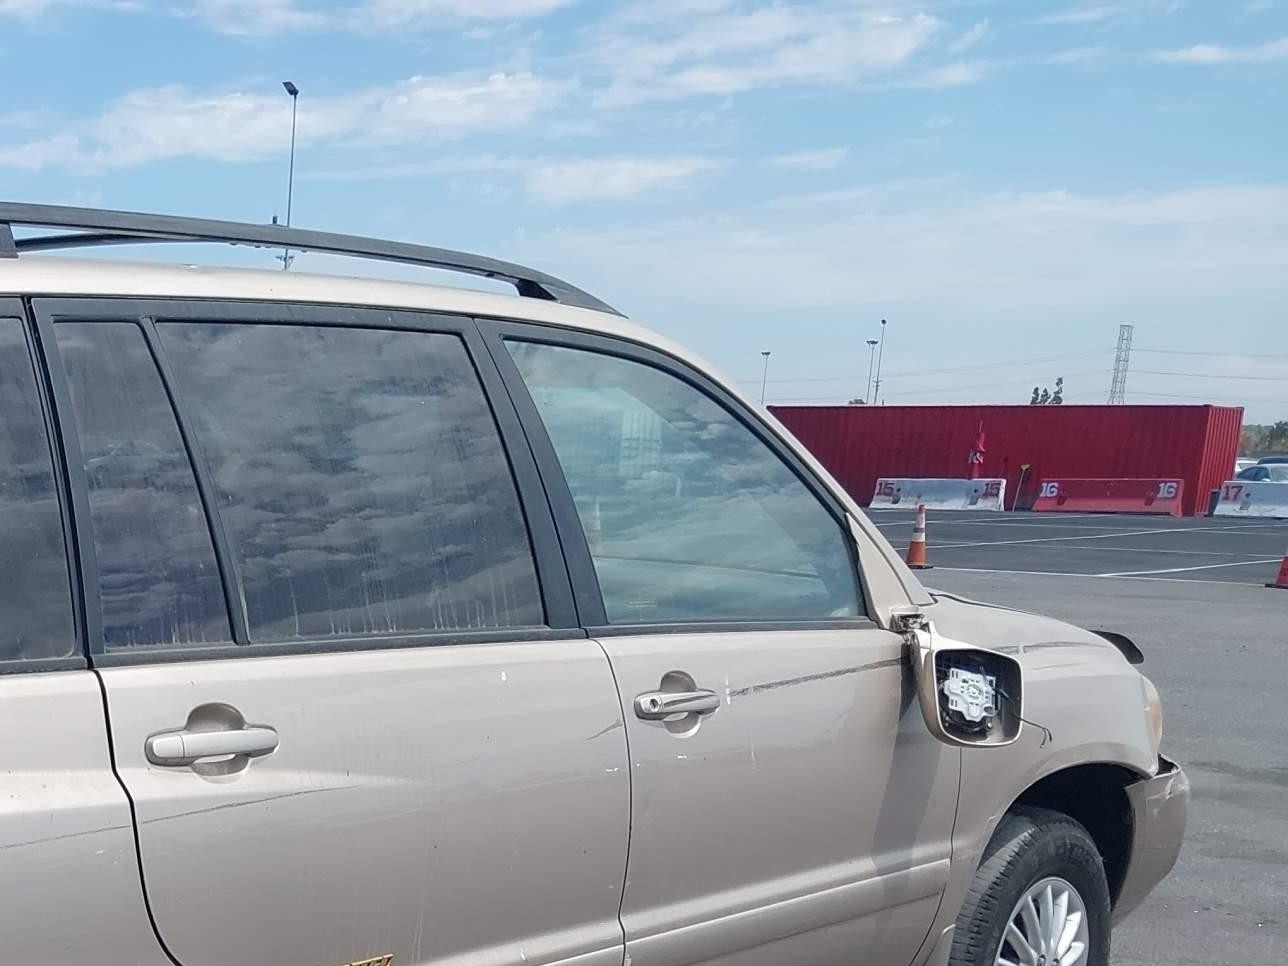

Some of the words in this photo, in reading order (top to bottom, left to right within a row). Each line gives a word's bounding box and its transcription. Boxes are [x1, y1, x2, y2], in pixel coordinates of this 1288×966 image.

[877, 482, 894, 497] 15
[983, 482, 1000, 497] 15
[1040, 482, 1059, 498] 16
[1157, 482, 1177, 498] 16
[1221, 485, 1243, 501] 17
